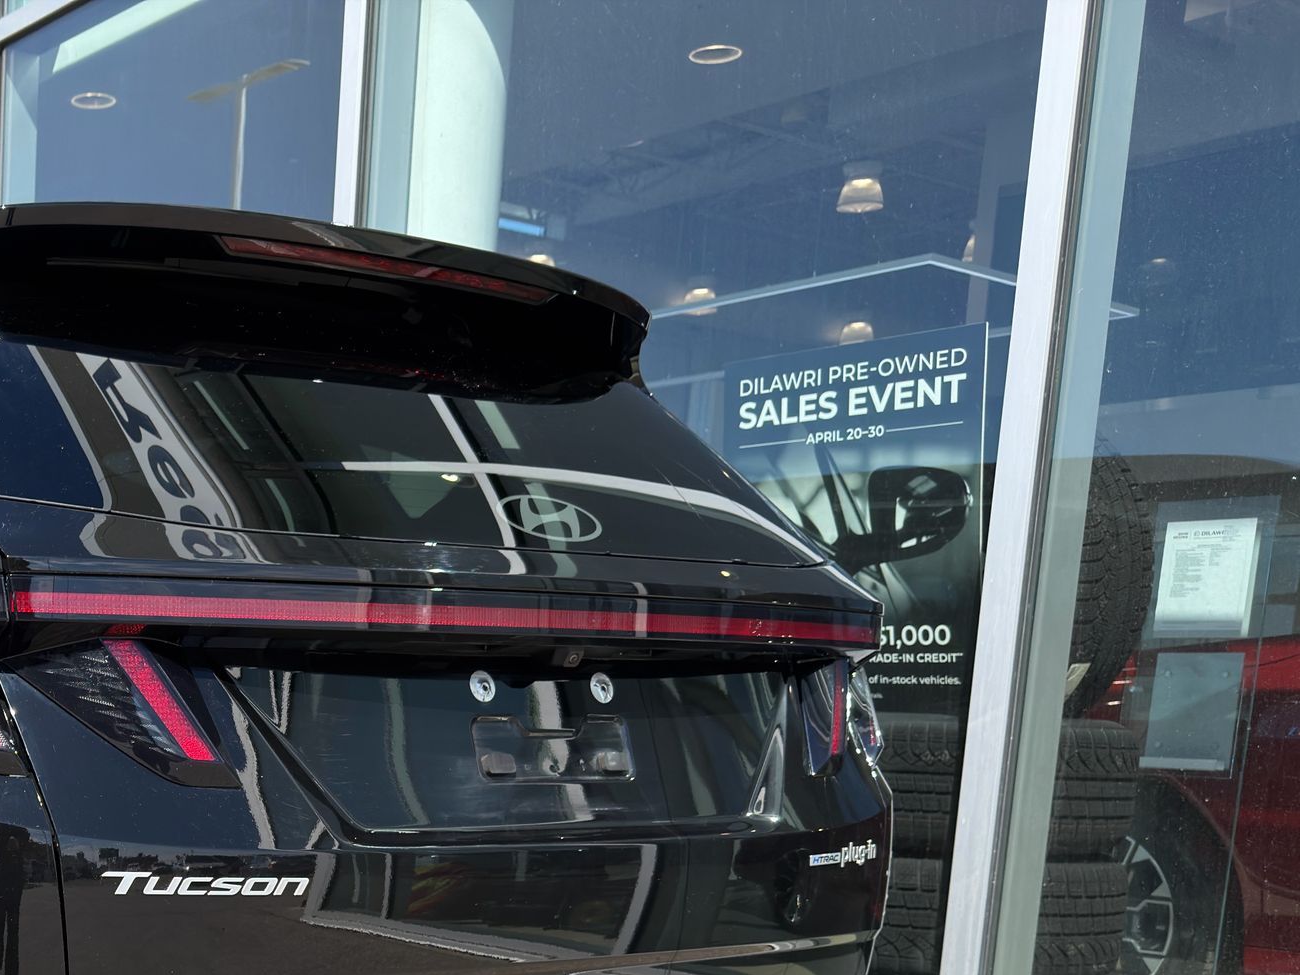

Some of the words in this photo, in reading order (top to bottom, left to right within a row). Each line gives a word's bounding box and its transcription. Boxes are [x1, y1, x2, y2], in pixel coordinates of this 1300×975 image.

[739, 368, 822, 397] DILAWRI
[828, 347, 967, 384] PRE-OWNED
[739, 390, 838, 430] SALES
[848, 373, 967, 416] EVENT
[805, 429, 844, 445] APRIL
[868, 652, 915, 663] ADE-IN
[868, 675, 879, 685] of
[880, 675, 918, 685] in-stock
[810, 853, 840, 866] HTRAC
[840, 839, 877, 868] plug-in
